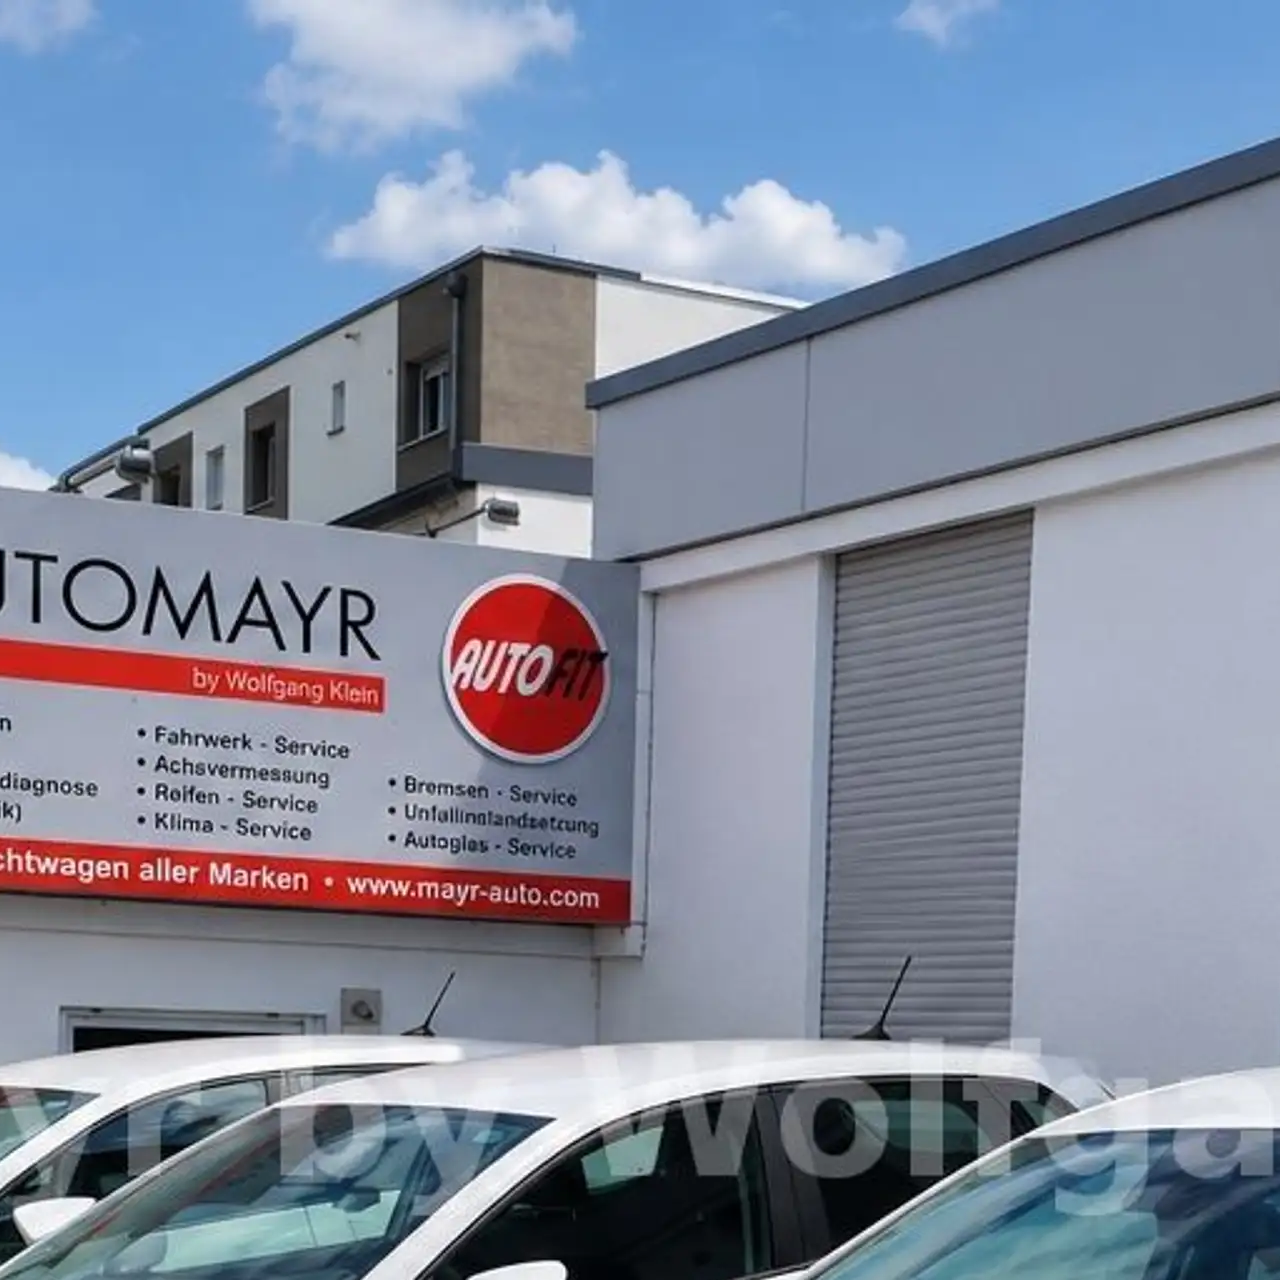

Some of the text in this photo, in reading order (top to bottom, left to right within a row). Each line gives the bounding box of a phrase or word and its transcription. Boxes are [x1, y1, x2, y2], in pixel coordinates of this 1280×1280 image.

[192, 667, 379, 706] by Wolfgang Klein
[450, 639, 608, 701] AUTOFIT
[154, 725, 253, 750] Fahrwerk
[274, 735, 350, 759] Service
[154, 755, 330, 789] Achsvermessung
[154, 783, 220, 805] Reifen
[242, 790, 318, 813] Service
[404, 775, 489, 799] Bremsen
[509, 785, 577, 808] Service
[154, 812, 214, 834] Klima
[236, 818, 312, 841] Service
[404, 803, 600, 839] Unfallinstandsetzung
[404, 831, 489, 854] Autoglas
[508, 838, 576, 860] Service
[139, 857, 200, 883] aller
[209, 861, 309, 891] Marken
[347, 876, 600, 909] www.mayr-auto.com
